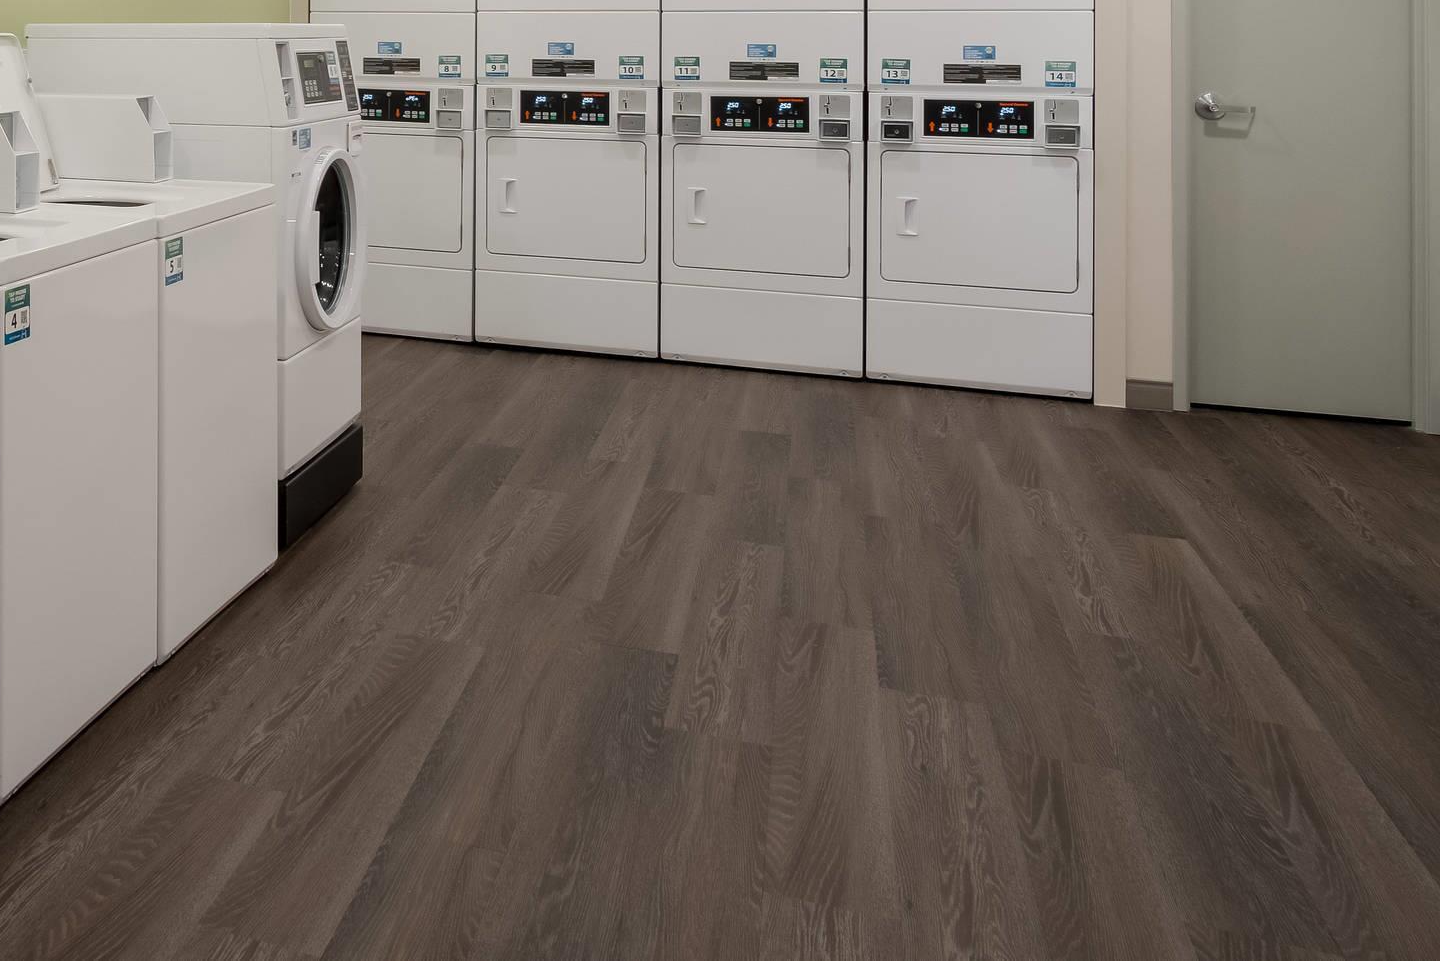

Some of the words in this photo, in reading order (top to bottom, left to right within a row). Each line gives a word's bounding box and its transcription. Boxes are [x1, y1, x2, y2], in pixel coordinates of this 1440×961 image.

[679, 67, 689, 75] 11
[824, 69, 836, 77] 12
[886, 70, 899, 78] 13
[1050, 72, 1063, 81] 14
[11, 313, 17, 329] 4
